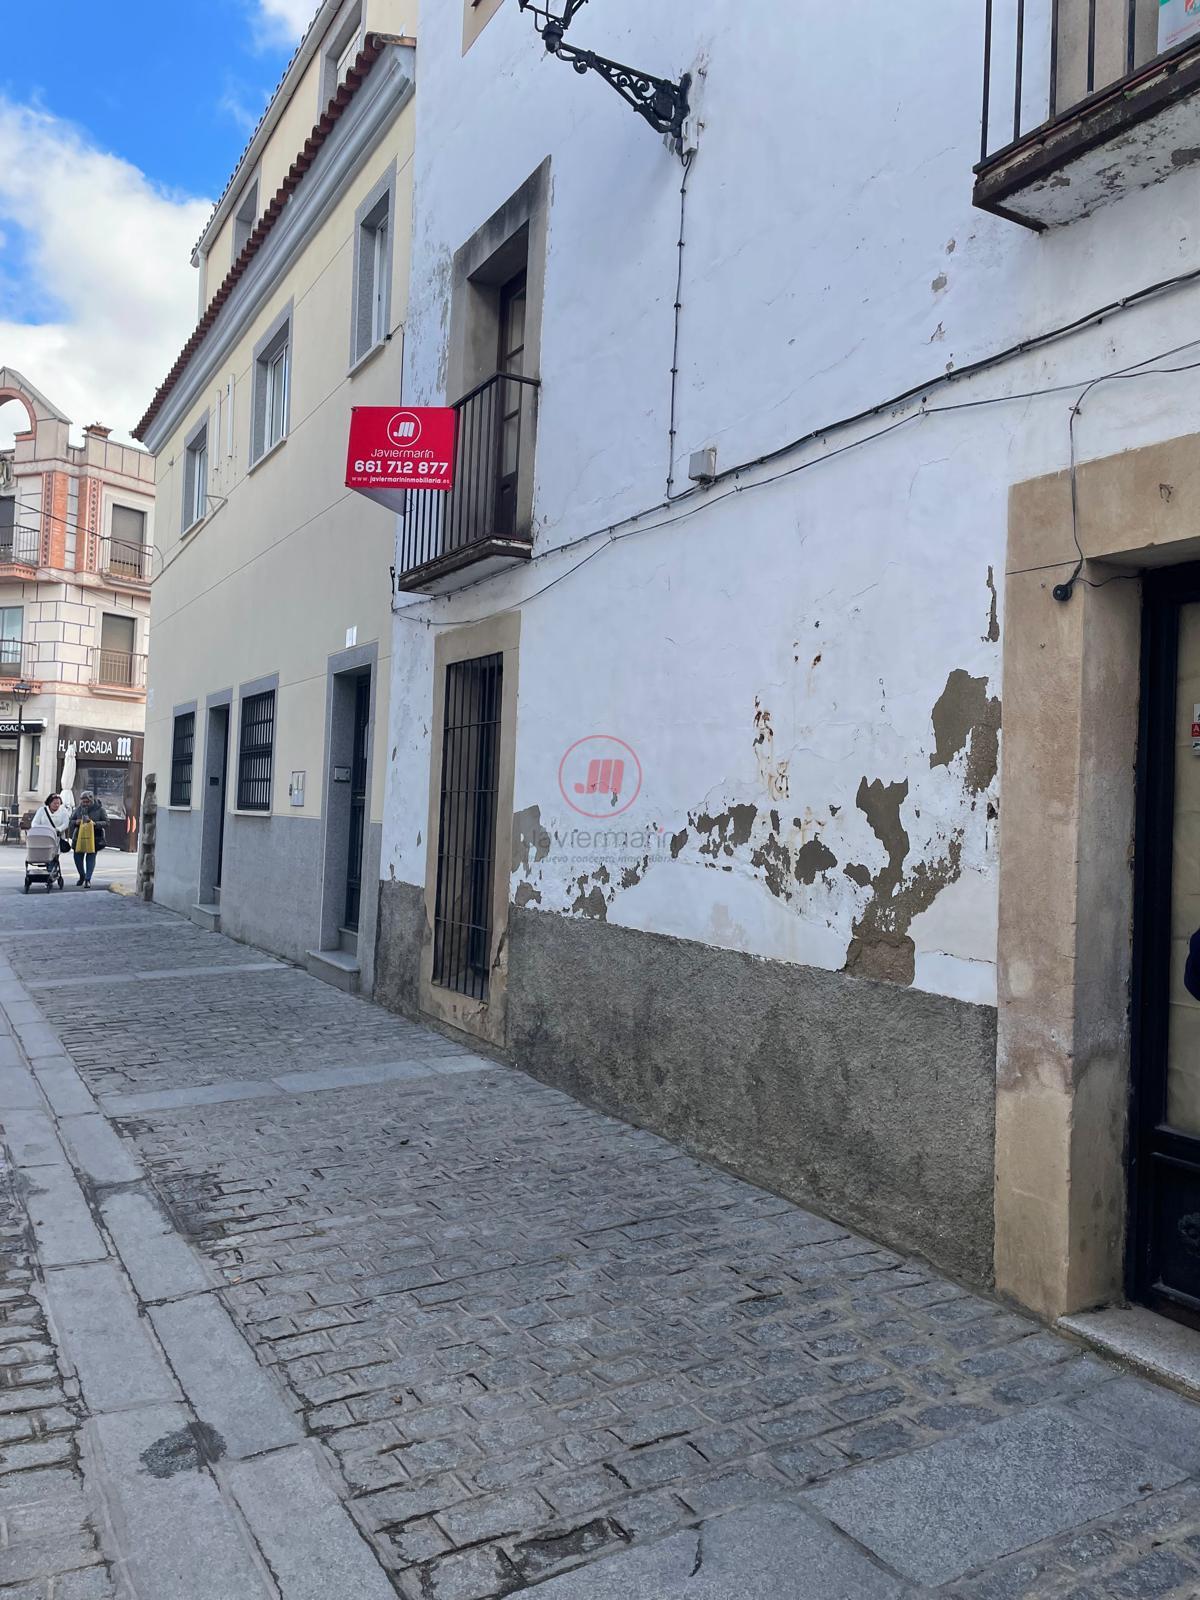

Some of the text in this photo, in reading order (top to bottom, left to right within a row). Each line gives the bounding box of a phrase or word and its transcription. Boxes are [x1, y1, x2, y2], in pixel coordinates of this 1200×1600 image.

[370, 448, 434, 459] Javiermarín
[354, 460, 449, 475] 661 712 877
[79, 740, 113, 754] POSADA
